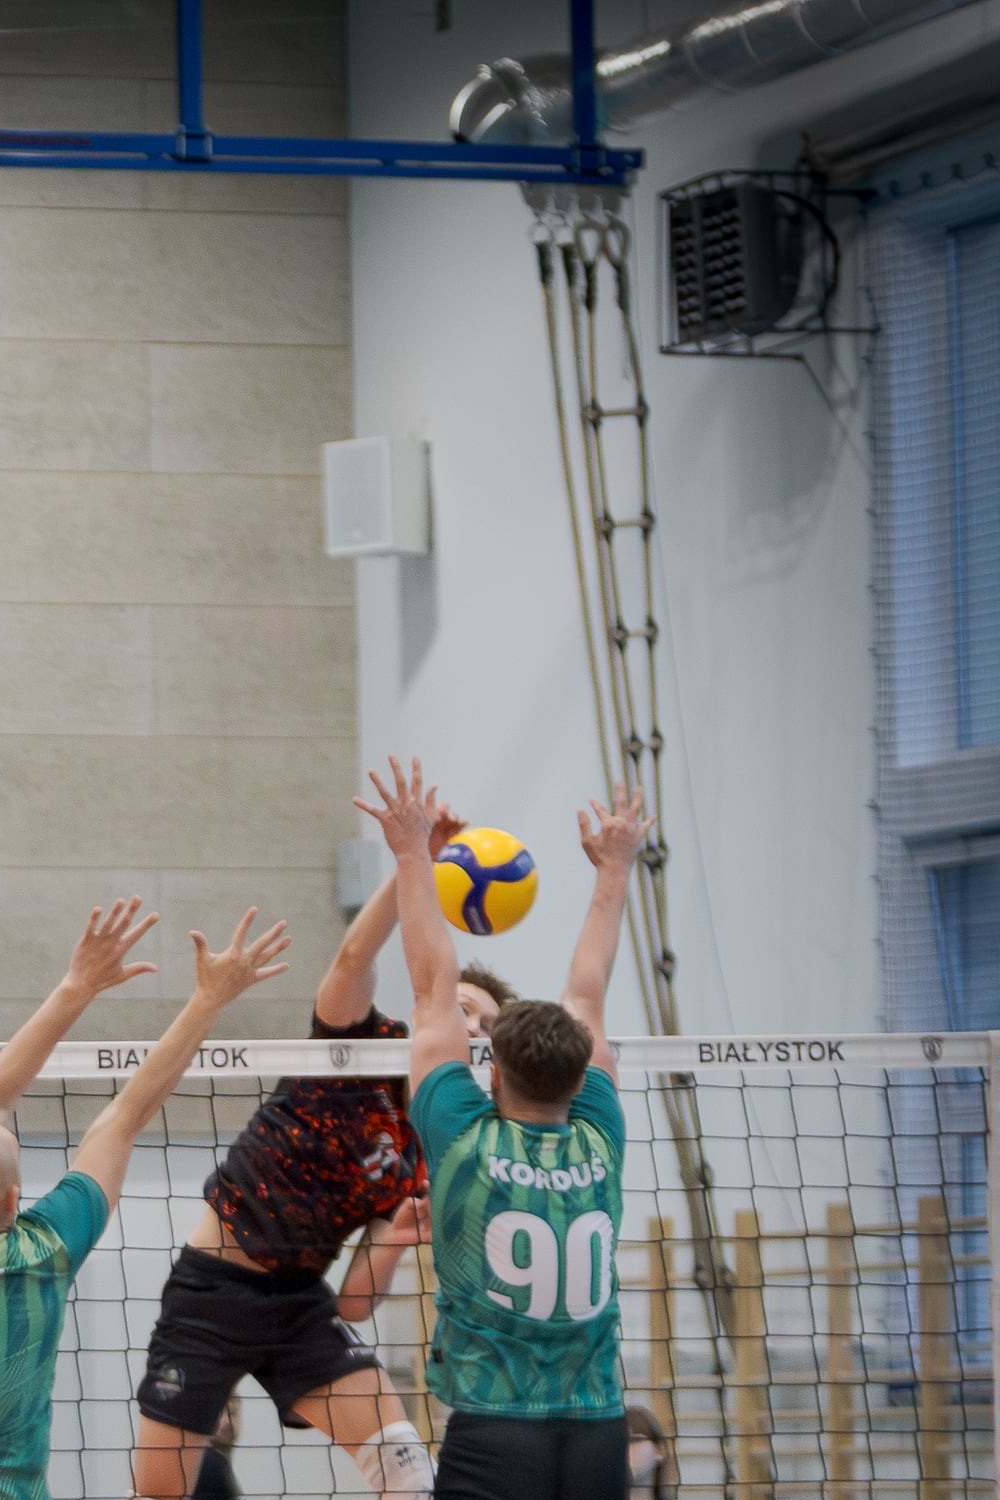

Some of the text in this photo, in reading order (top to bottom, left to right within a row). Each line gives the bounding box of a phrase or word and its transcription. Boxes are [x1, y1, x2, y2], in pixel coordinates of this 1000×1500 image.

[98, 1047, 248, 1069] BIATOK
[699, 1040, 845, 1064] BIAŁYSTOK
[488, 1151, 607, 1191] KORDUŚ
[485, 1210, 615, 1321] 90
